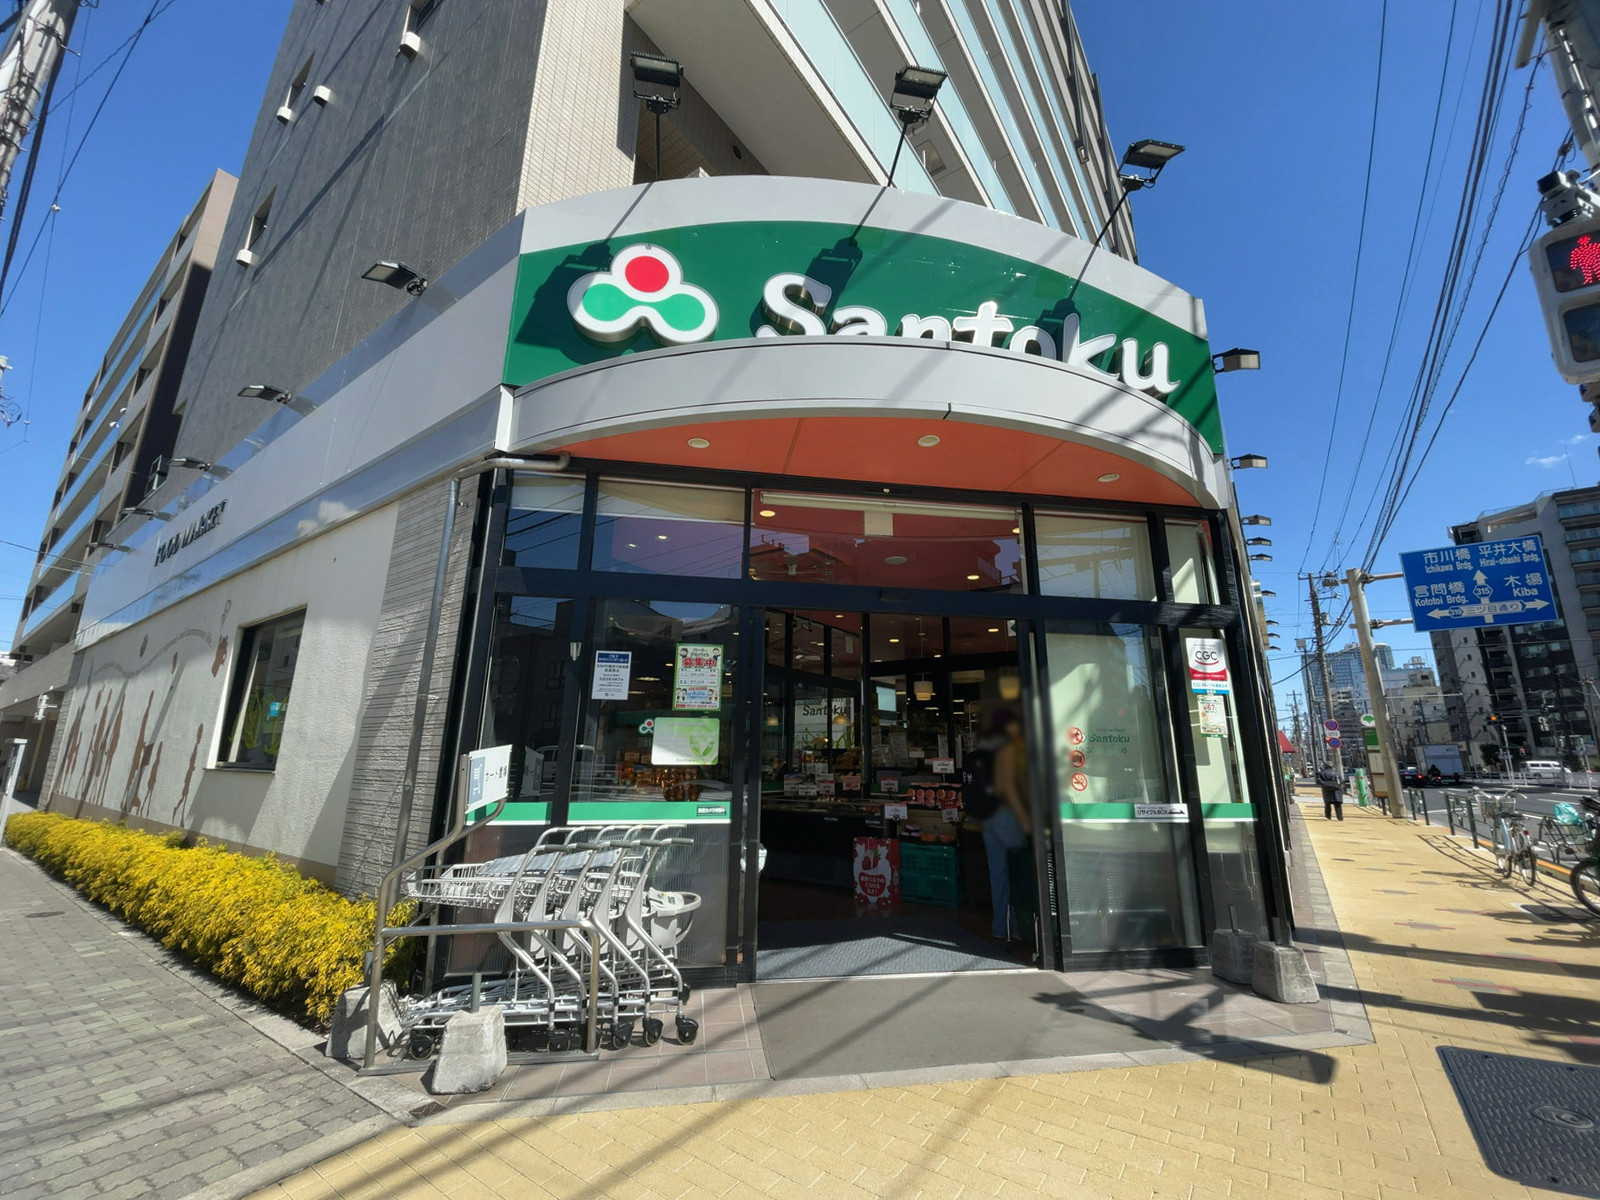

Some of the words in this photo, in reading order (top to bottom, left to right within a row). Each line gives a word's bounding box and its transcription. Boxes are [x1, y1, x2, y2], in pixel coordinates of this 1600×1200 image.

[756, 272, 1180, 392] Santoku
[154, 531, 181, 567] FOOD
[181, 498, 228, 548] MARKET
[1424, 548, 1470, 564] 市川橋
[1479, 539, 1536, 557] 平井大橋
[1523, 552, 1541, 563] Brdg.
[1425, 564, 1453, 574] Ichikawa
[1504, 573, 1543, 587] 木場
[1413, 581, 1465, 598] 言問橋
[1475, 587, 1489, 595] 315
[1513, 587, 1538, 597] Kiba
[1466, 601, 1519, 615] 三ツ目通り
[1195, 650, 1218, 661] CGC
[683, 657, 715, 668] 募集中
[803, 705, 848, 716] Santku
[1089, 734, 1130, 743] Santoku
